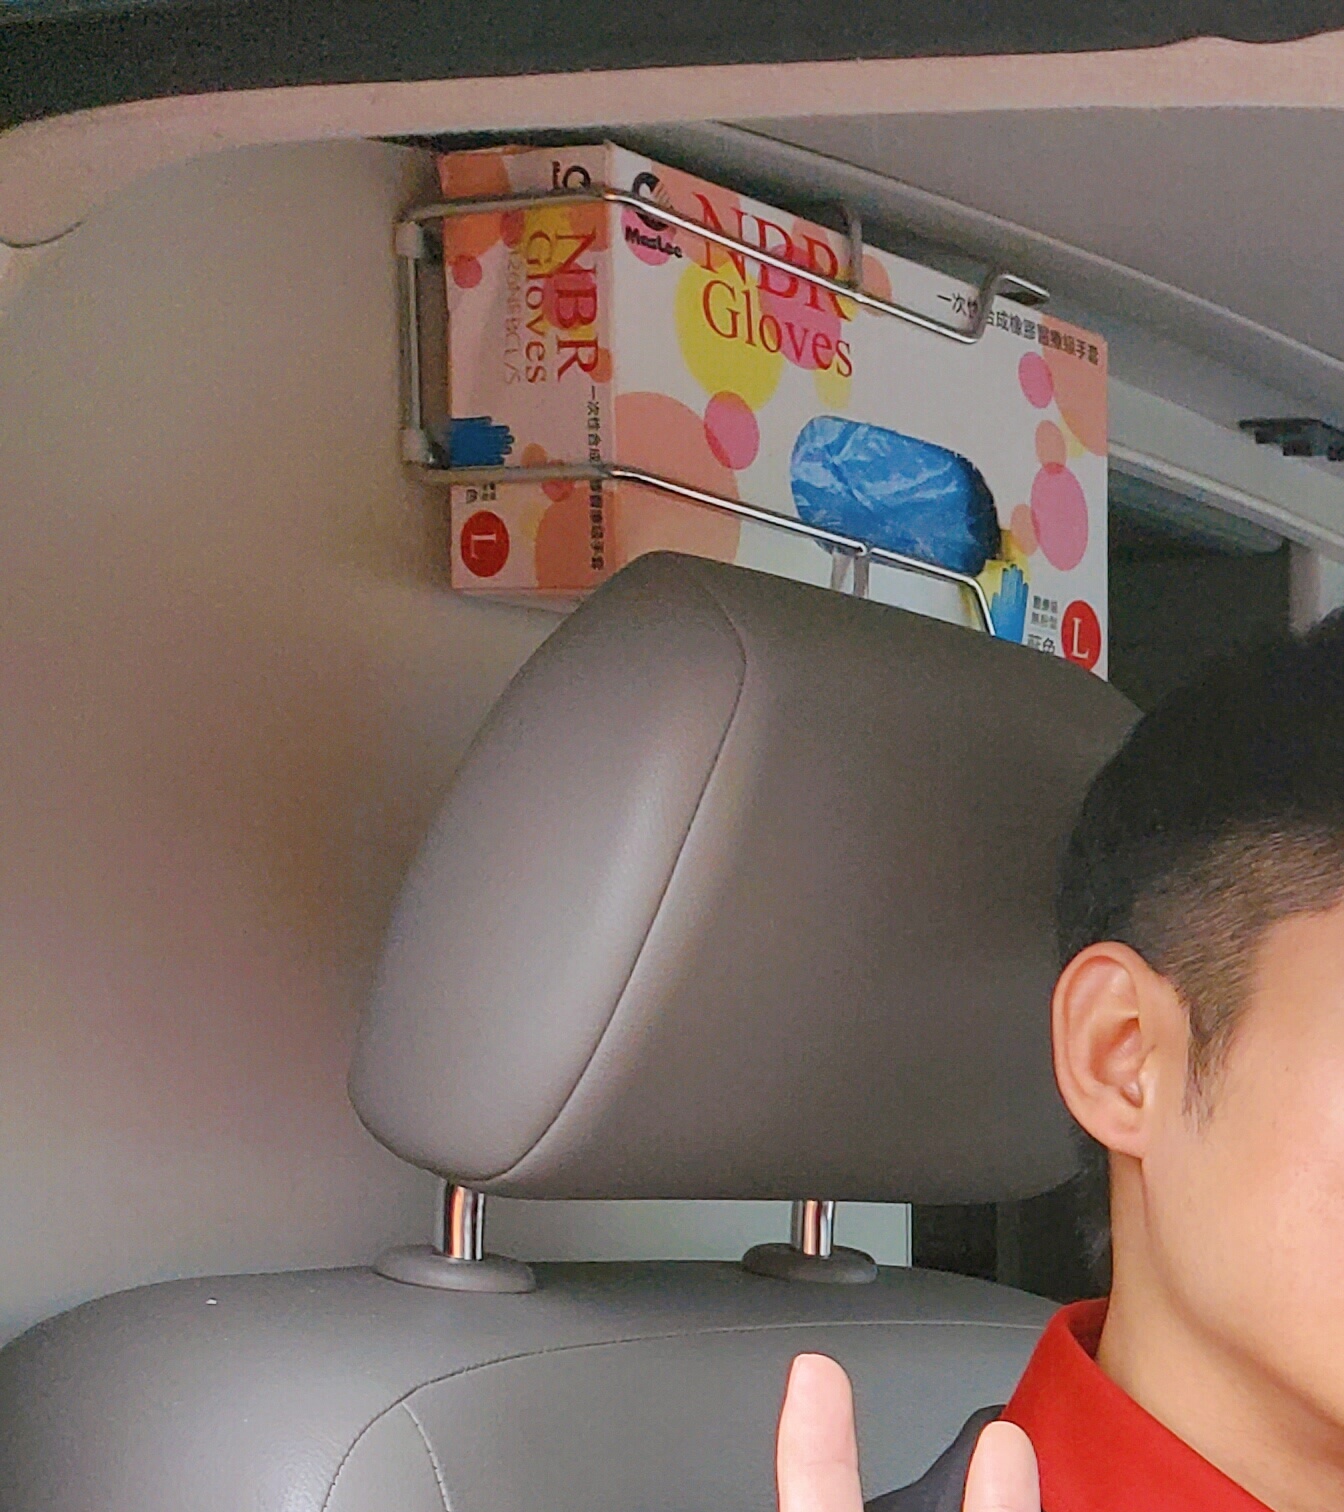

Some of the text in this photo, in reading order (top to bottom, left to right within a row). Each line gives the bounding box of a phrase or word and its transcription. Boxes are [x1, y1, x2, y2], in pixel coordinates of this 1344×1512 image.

[525, 231, 552, 385] Gloves
[556, 227, 599, 383] NBR
[692, 192, 852, 322] NBR
[702, 280, 853, 378] Gloves
[470, 533, 497, 560] L
[1071, 617, 1090, 660] L
